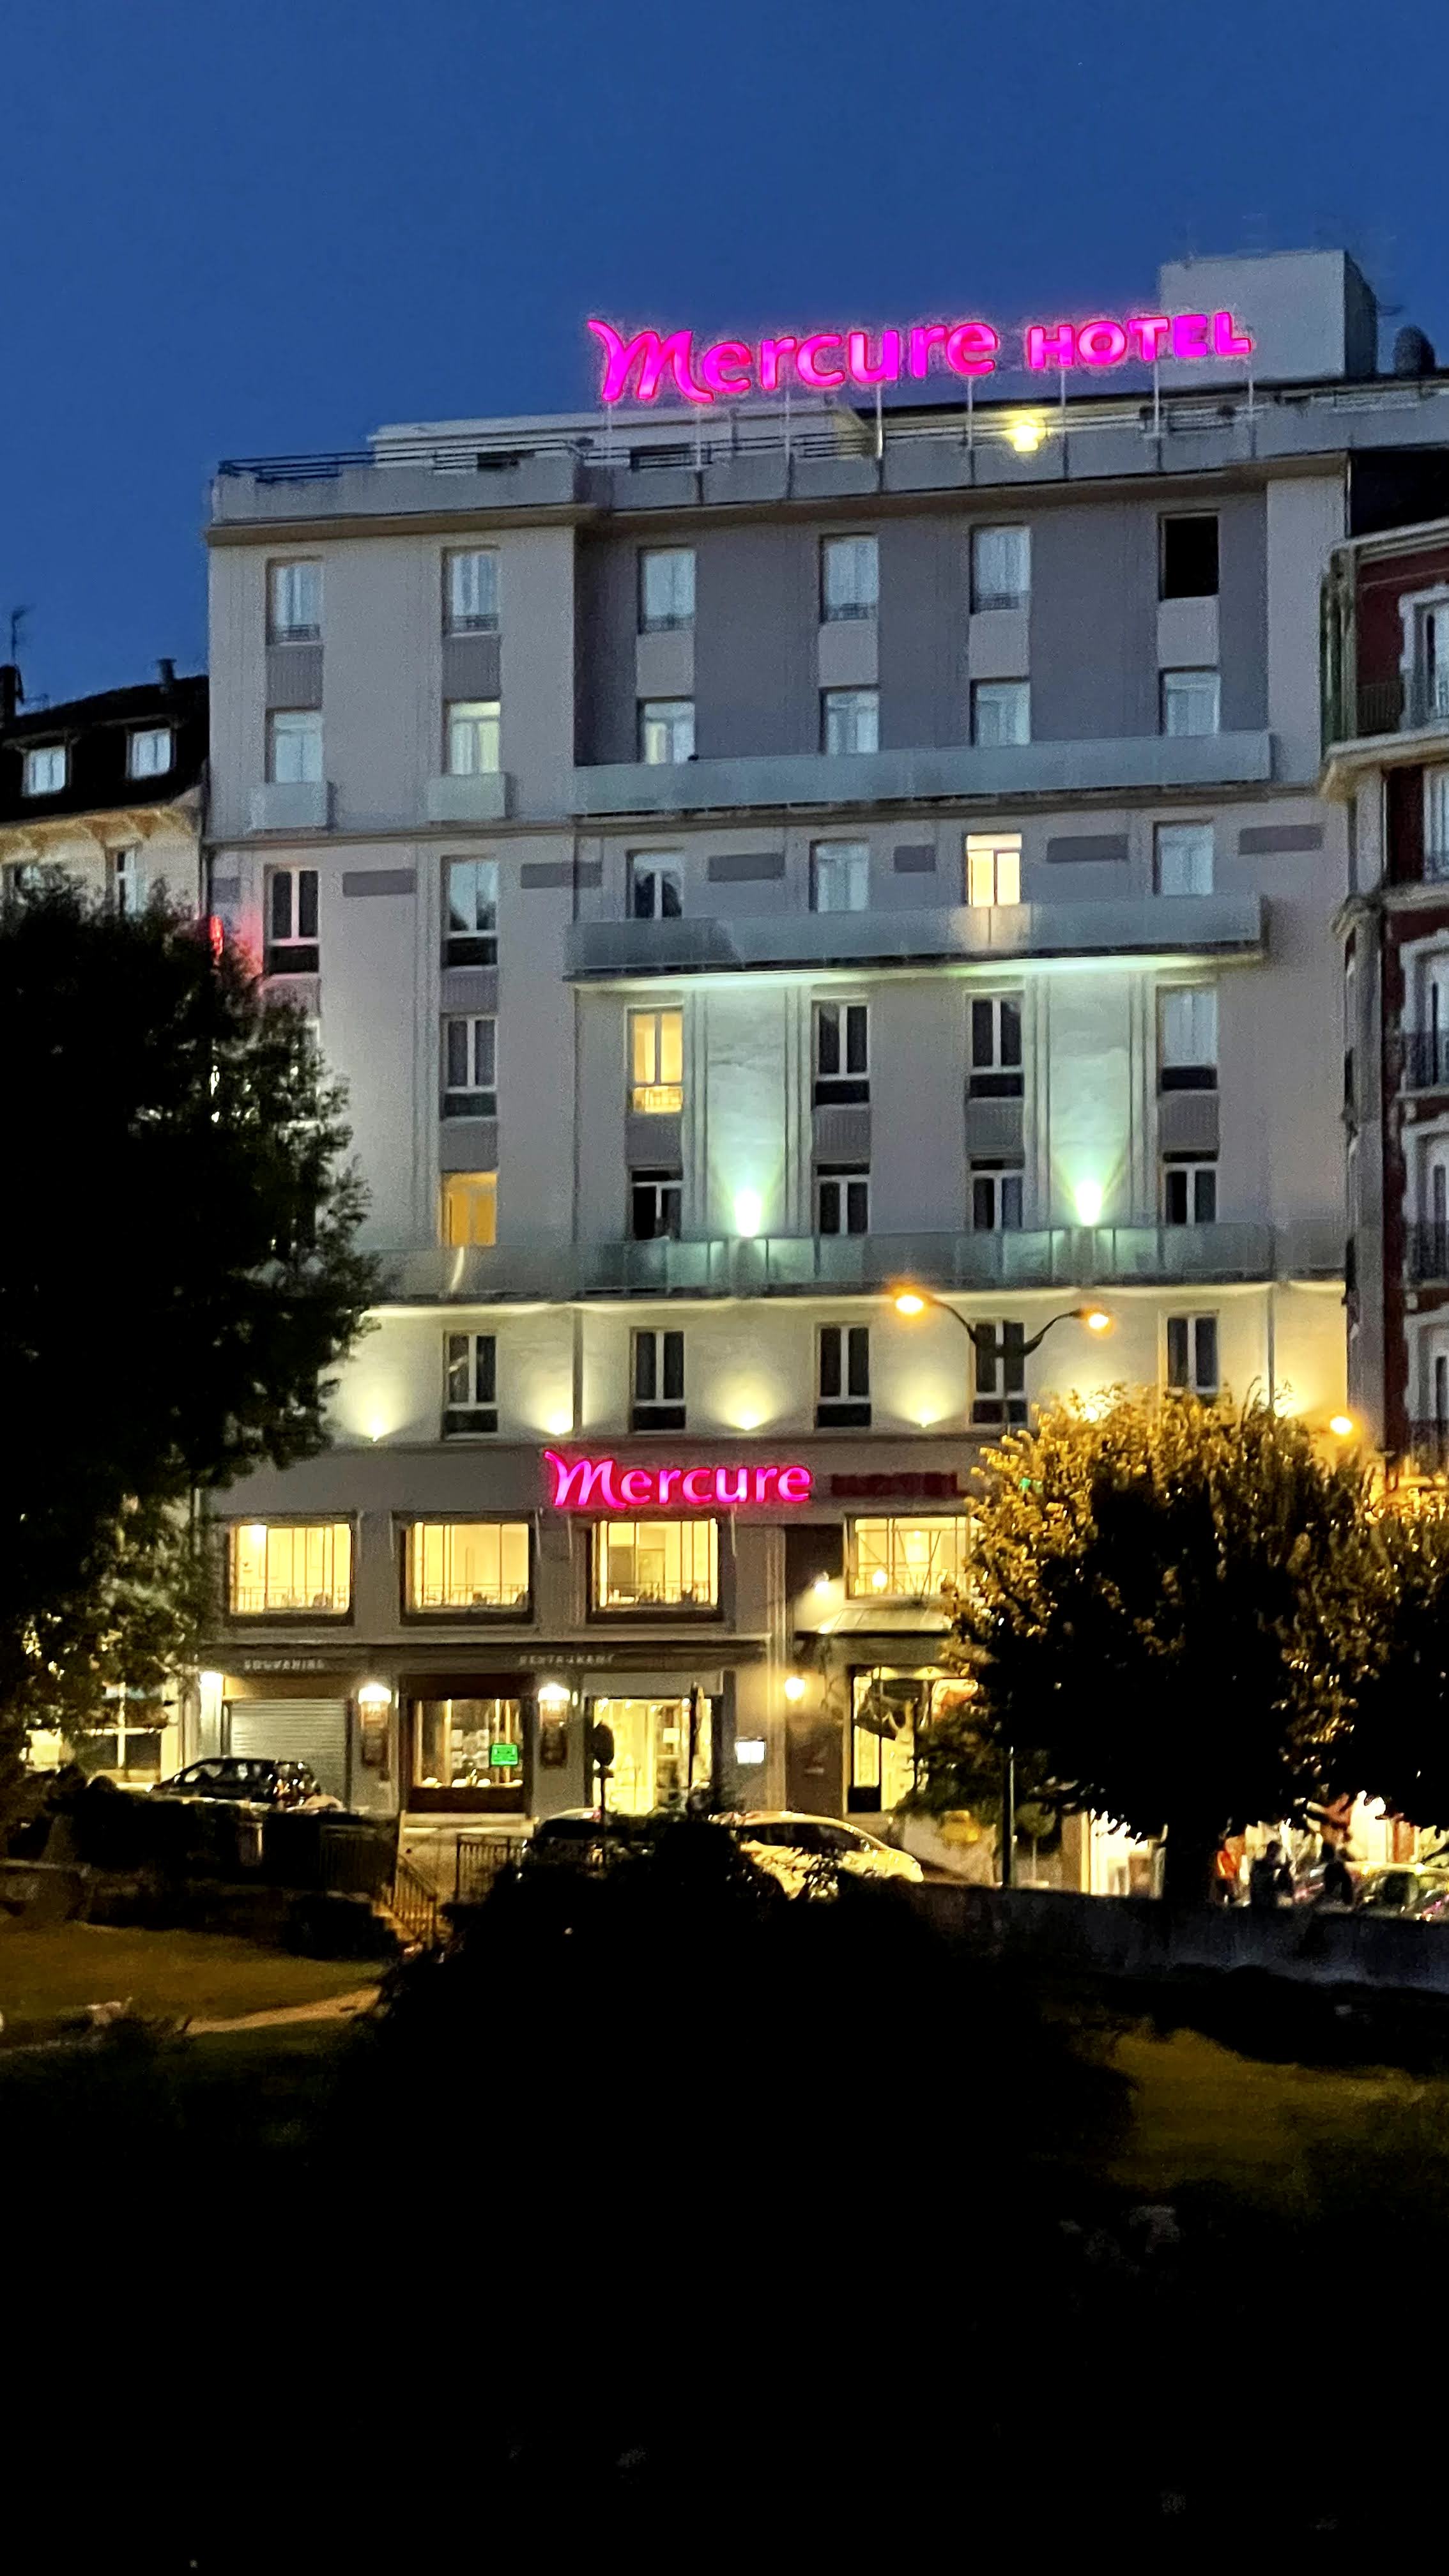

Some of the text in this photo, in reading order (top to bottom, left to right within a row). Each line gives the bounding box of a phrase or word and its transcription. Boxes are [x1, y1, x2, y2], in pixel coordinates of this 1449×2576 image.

[588, 311, 1251, 403] Mercure HOTEL
[544, 1451, 811, 1509] Mercure
